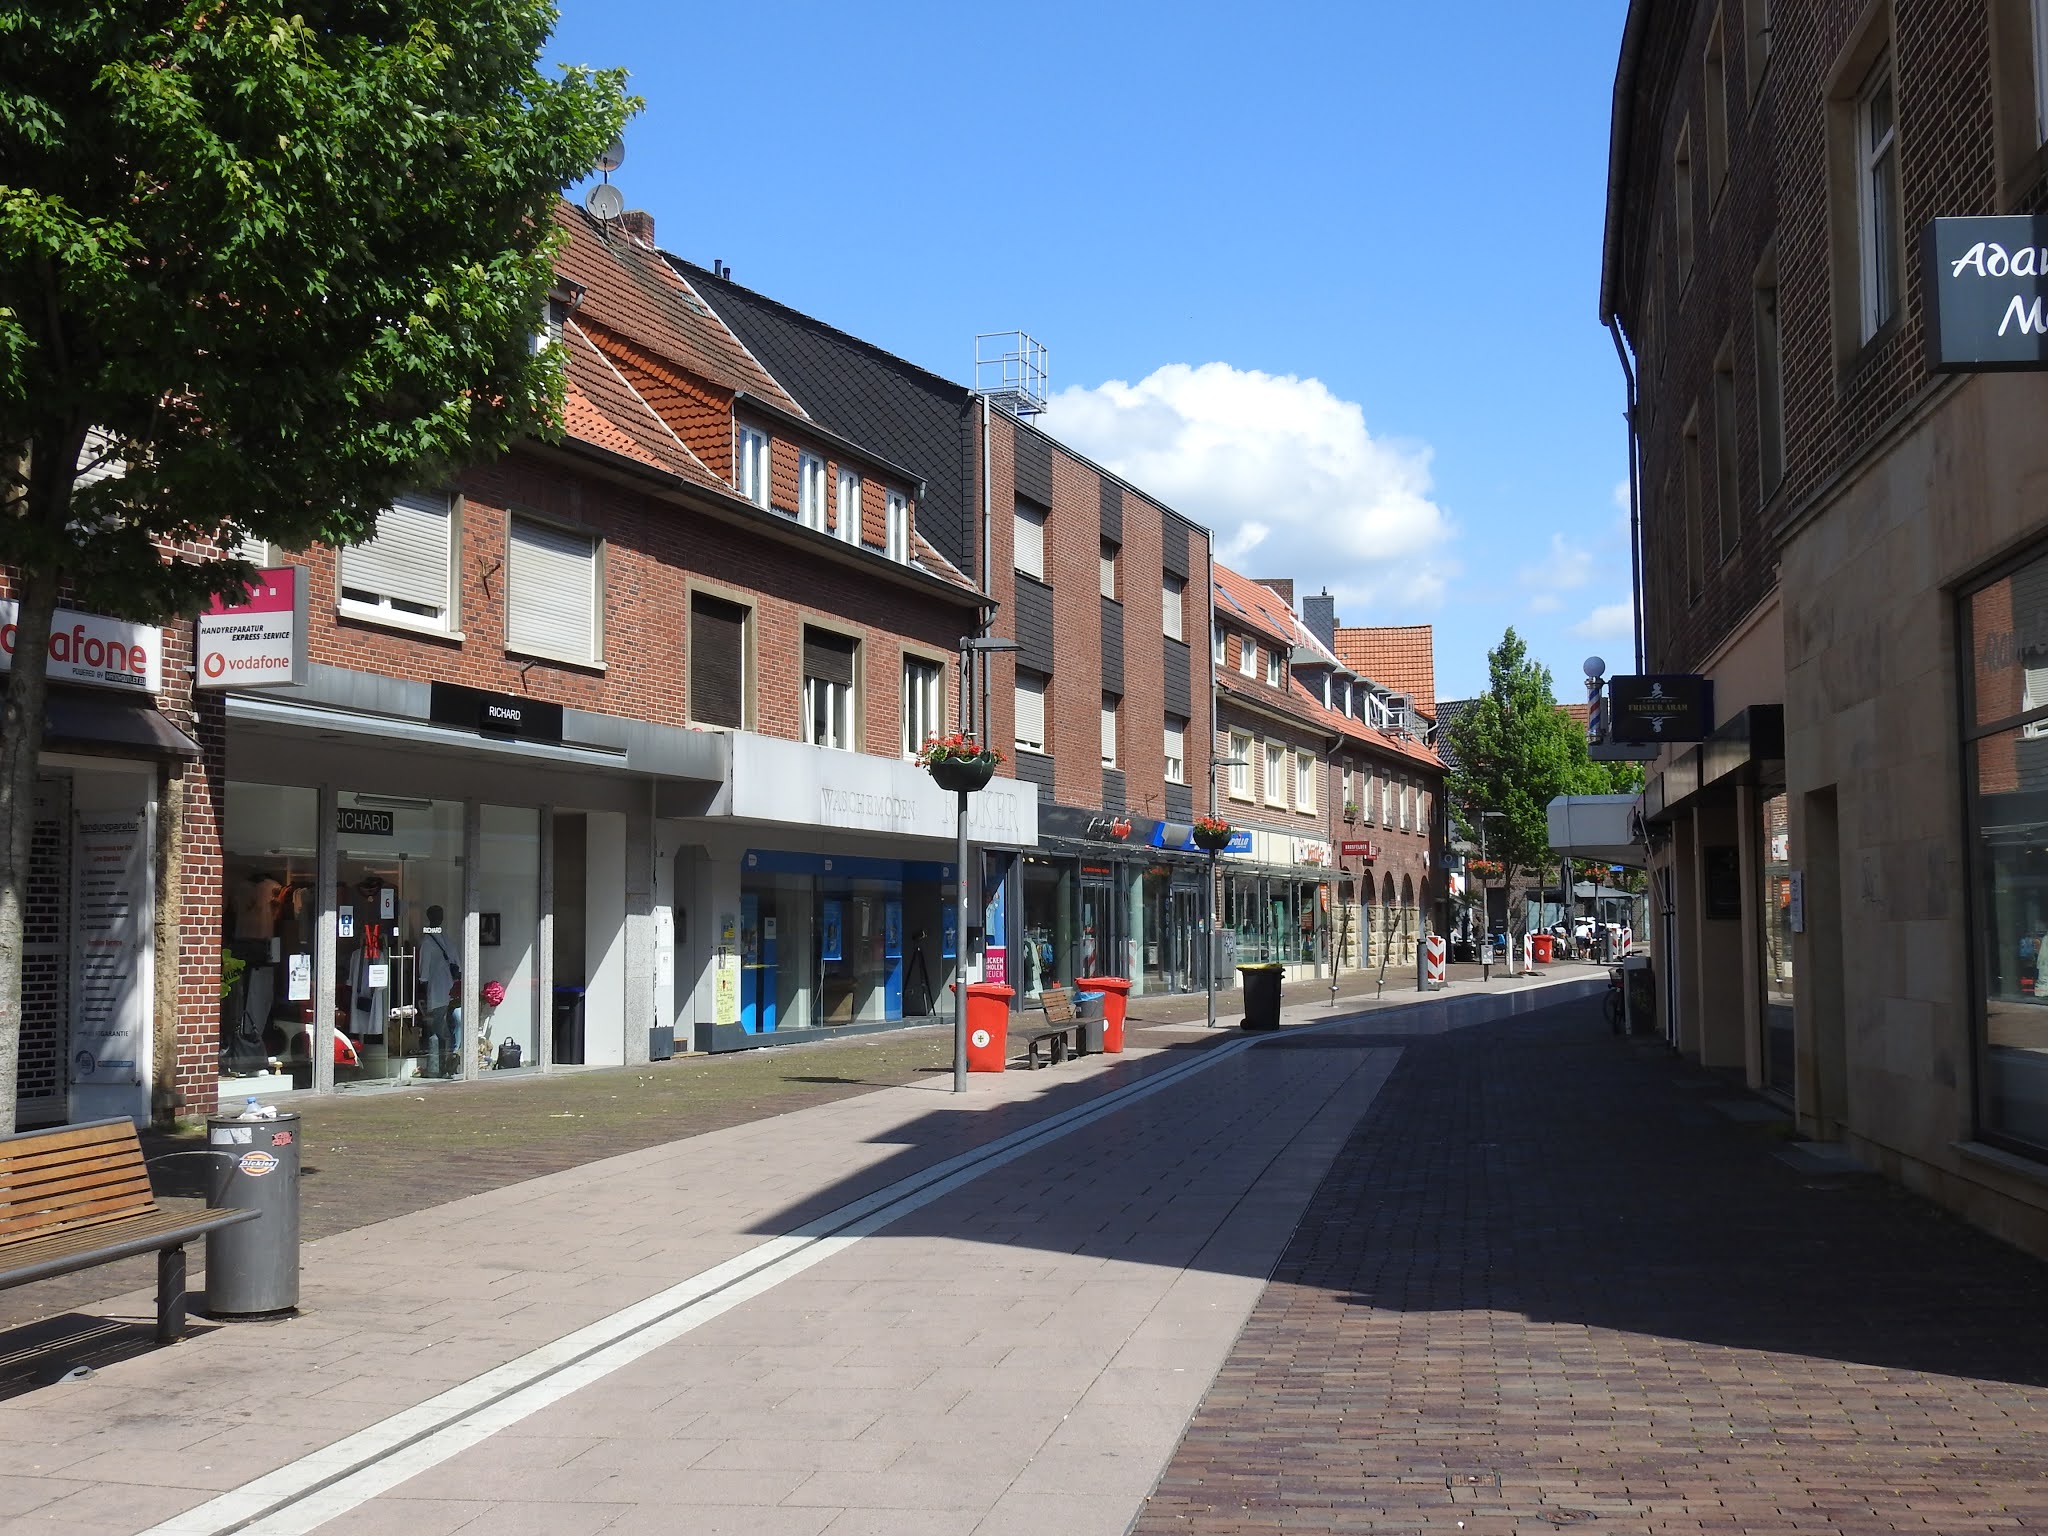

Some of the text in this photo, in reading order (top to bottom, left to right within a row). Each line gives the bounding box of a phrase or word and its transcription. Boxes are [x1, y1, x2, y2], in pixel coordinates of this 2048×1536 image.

[1998, 295, 2048, 337] M
[201, 625, 264, 635] HANDYREPARATUR
[231, 631, 290, 641] EXPRESS SERVICE
[228, 655, 290, 670] vodafone
[489, 705, 521, 721] RICHARD
[385, 898, 390, 909] 6
